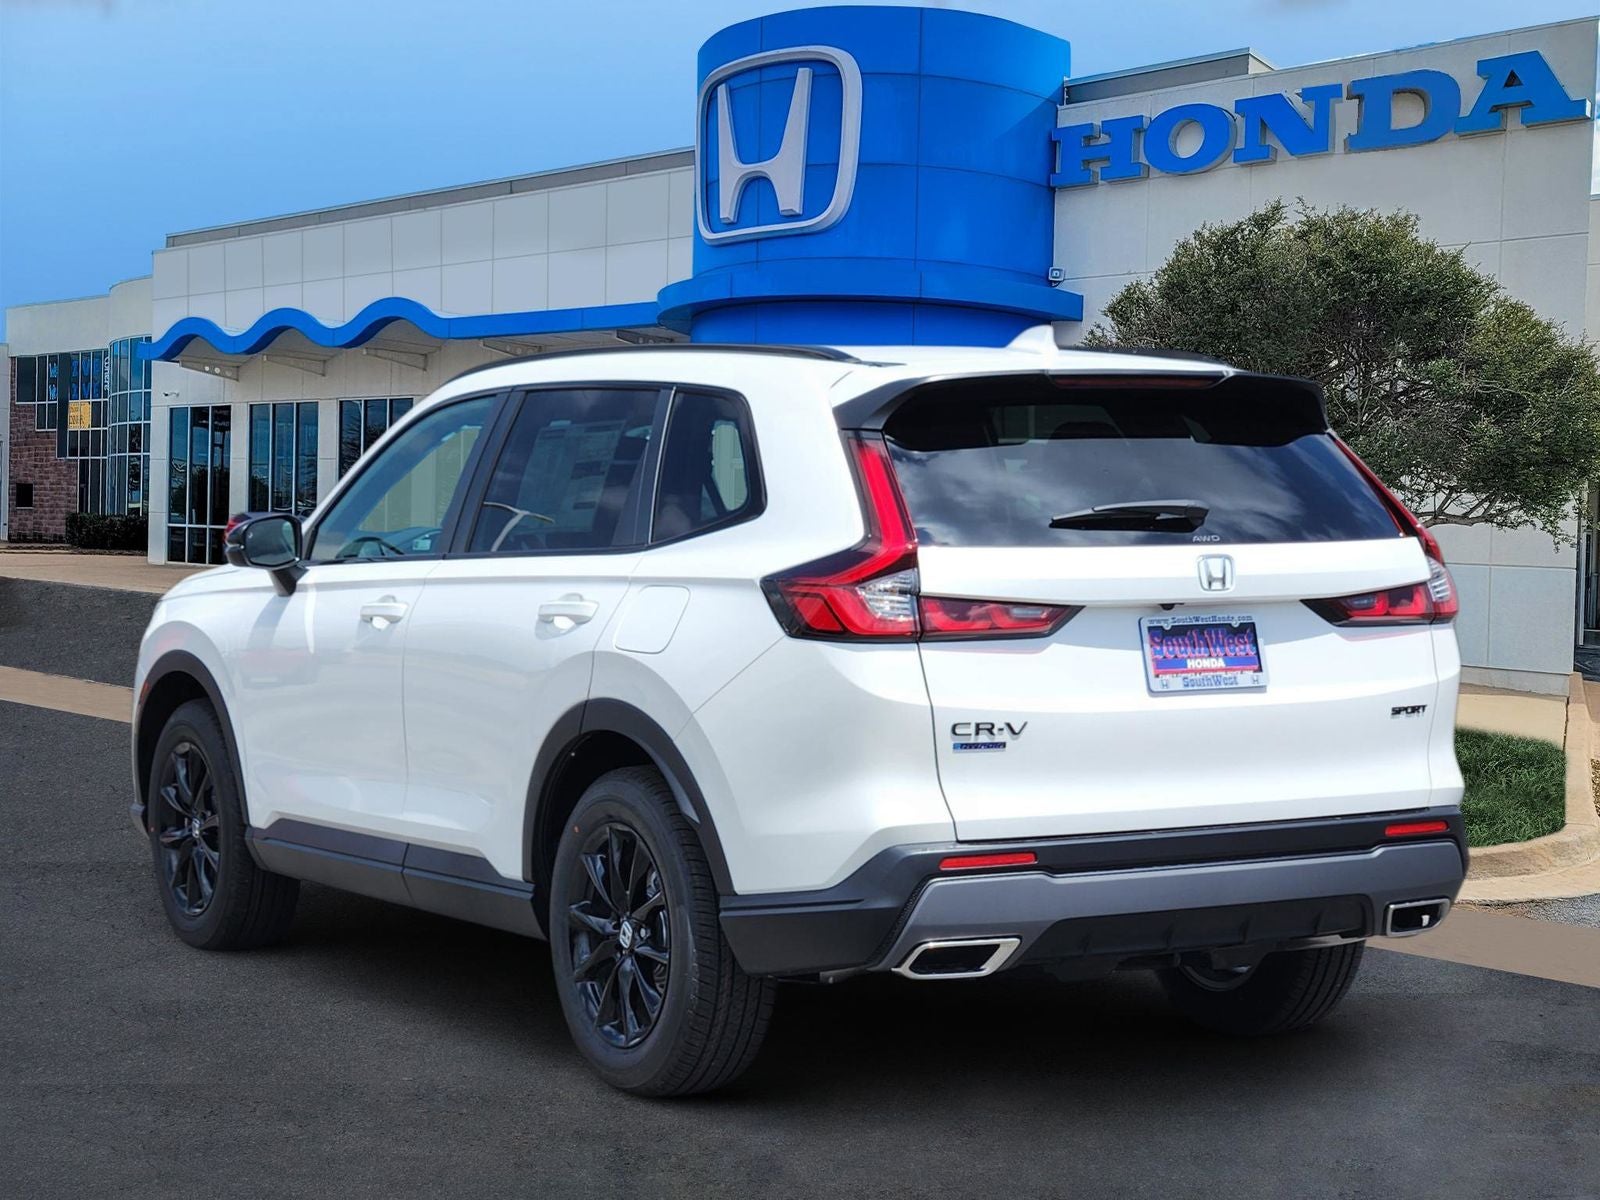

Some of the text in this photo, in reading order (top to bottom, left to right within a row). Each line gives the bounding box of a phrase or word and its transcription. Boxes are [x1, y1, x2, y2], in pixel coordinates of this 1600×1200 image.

[1050, 49, 1592, 189] HONDA
[1192, 535, 1221, 543] AWD
[1186, 658, 1227, 669] HONDA
[1182, 675, 1239, 688] SouthWest
[1391, 704, 1428, 716] SPORT
[951, 721, 1028, 736] CR-V
